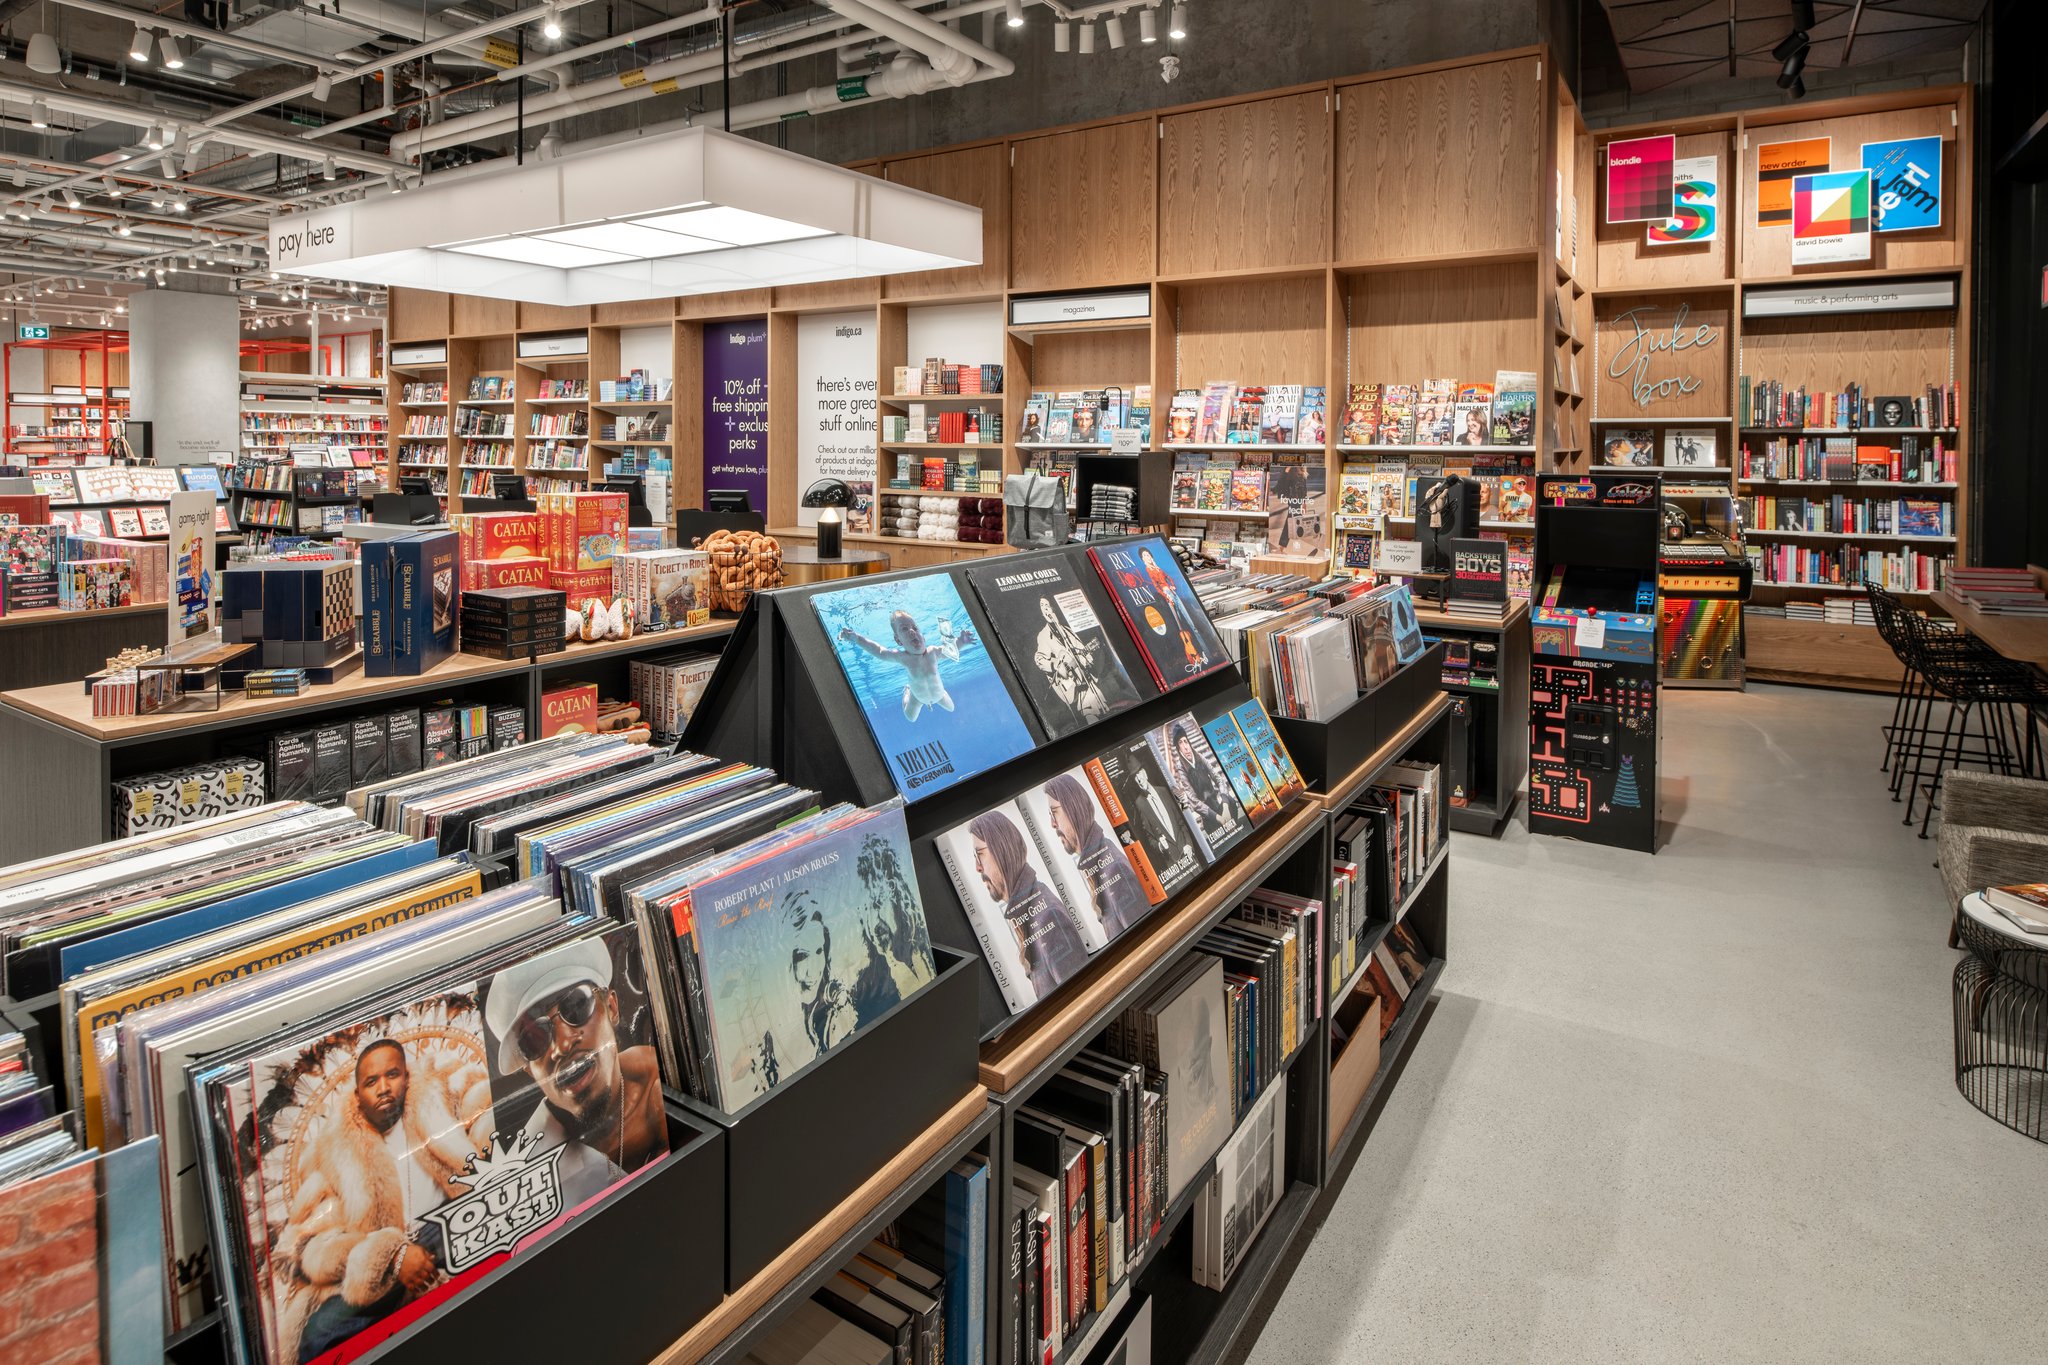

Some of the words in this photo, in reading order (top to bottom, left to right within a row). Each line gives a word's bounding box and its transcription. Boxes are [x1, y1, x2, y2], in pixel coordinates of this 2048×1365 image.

[1610, 156, 1642, 167] blondie
[1760, 162, 1779, 171] new
[1781, 159, 1807, 169] order
[278, 232, 303, 261] pay
[306, 219, 335, 247] here
[1795, 237, 1817, 247] david
[1818, 236, 1843, 246] bowie
[1794, 296, 1818, 305] music
[1820, 295, 1828, 304] &
[1829, 293, 1879, 306] performing
[1881, 292, 1899, 301] arts
[1063, 305, 1096, 316] magazines
[835, 326, 862, 338] indigo.ca
[1608, 302, 1718, 378] Juke
[724, 380, 745, 395] 10%
[746, 378, 761, 395] off
[817, 376, 851, 392] there's
[1632, 354, 1702, 408] box
[712, 397, 733, 412] free
[818, 400, 847, 410] more
[1077, 400, 1098, 408] Inc.
[1348, 403, 1374, 412] MAD
[819, 415, 841, 431] stuff
[844, 416, 877, 431] online
[817, 445, 836, 454] Check
[815, 455, 822, 464] of
[822, 456, 847, 466] products
[712, 465, 722, 474] get
[721, 465, 735, 473] what
[734, 466, 745, 475] you
[745, 465, 758, 474] love,
[819, 466, 828, 474] for
[829, 466, 846, 475] home
[847, 467, 870, 478] delivery
[186, 474, 218, 482] sunday
[1371, 474, 1402, 483] DREW
[578, 500, 598, 508] CATAN
[1280, 493, 1315, 504] favourite
[1288, 507, 1306, 515] tech
[178, 515, 196, 528] game
[195, 510, 211, 523] night
[494, 521, 537, 538] CATAN
[1108, 550, 1135, 570] RUN
[1455, 552, 1501, 560] BACKSTREET
[654, 561, 681, 575] TICKET
[689, 558, 706, 569] RIDE
[1455, 559, 1502, 573] BOYS
[500, 567, 544, 585] CATAN
[580, 575, 606, 587] CATAN
[995, 572, 1034, 587] LEONARD
[1033, 568, 1059, 580] COHEN
[403, 564, 412, 610] SCRABBLE
[1128, 585, 1156, 606] RUN
[688, 613, 697, 625] 10
[371, 609, 382, 654] SCRABBLE
[680, 671, 707, 685] TICKET
[547, 694, 591, 718] CATAN
[389, 714, 408, 723] Cards
[498, 712, 521, 722] BUZZED
[1244, 708, 1259, 720] DOLLY
[354, 720, 374, 729] Cards
[390, 718, 413, 728] Against
[390, 723, 418, 734] Humanity
[1246, 715, 1264, 729] PARTON
[317, 729, 337, 739] Cards
[354, 725, 378, 735] Against
[354, 730, 384, 741] Humanity
[426, 727, 453, 738] Absurd
[1214, 724, 1231, 737] DOLLY
[1256, 728, 1270, 743] JAMES
[279, 737, 299, 747] Cards
[317, 733, 342, 744] Against
[317, 738, 348, 750] Humanity
[426, 736, 442, 745] Box
[1216, 731, 1236, 746] PARTON
[278, 741, 305, 753] Against
[278, 746, 311, 759] Humanity
[1227, 745, 1242, 760] JAMES
[895, 739, 950, 777] NIRVANA
[1224, 751, 1251, 772] PATTERSON
[906, 763, 956, 790] NEVERMIND
[1091, 765, 1112, 798] LEONARD
[1105, 795, 1121, 819] COHEN
[315, 798, 339, 807] Humanity
[1208, 826, 1226, 843] LEONARD
[1023, 810, 1053, 867] STORYTELLER
[1056, 882, 1071, 907] Dave
[1067, 906, 1085, 932] Grohl
[1083, 862, 1101, 879] Dave
[1097, 854, 1115, 872] Grohl
[1158, 863, 1180, 884] LEONARD
[1178, 854, 1193, 872] COHEN
[713, 888, 749, 913] ROBERT
[748, 877, 776, 898] PLANT
[783, 862, 813, 884] ALISON
[809, 850, 841, 872] KRAUSS
[1099, 872, 1108, 880] THE
[1093, 873, 1122, 896] STORYTELLER
[1010, 910, 1030, 929] Dave
[1027, 898, 1048, 918] Grohl
[944, 853, 977, 916] STORYTELLER
[980, 933, 995, 961] Dave
[992, 960, 1010, 989] Grohl
[1030, 920, 1040, 930] THE
[1023, 921, 1056, 948] STORYTELLER
[449, 1160, 554, 1235] OUT
[451, 1190, 558, 1263] KAST
[1026, 1206, 1037, 1268] SLASH
[1011, 1218, 1021, 1280] SLASH
